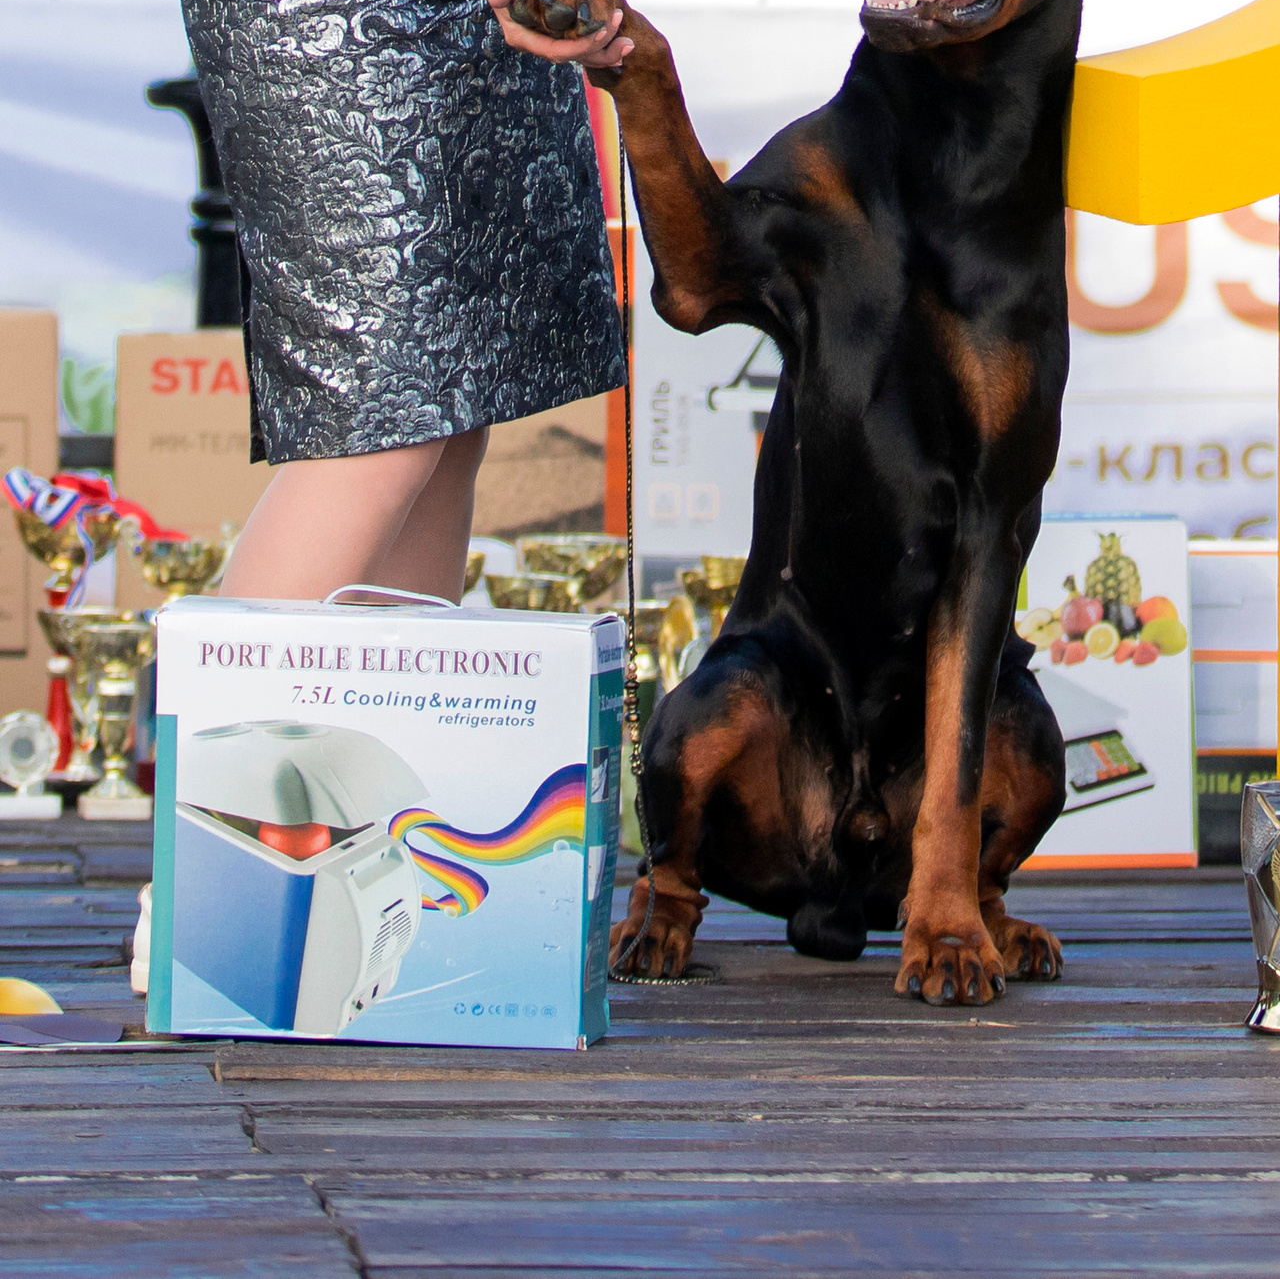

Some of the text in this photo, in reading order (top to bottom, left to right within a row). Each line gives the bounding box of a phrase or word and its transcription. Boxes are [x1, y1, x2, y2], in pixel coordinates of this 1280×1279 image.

[200, 642, 543, 678] PORT ABLE ELECTRONIC
[291, 685, 538, 714] 7.5L Cooling&warming
[438, 711, 536, 729] refrigerators
